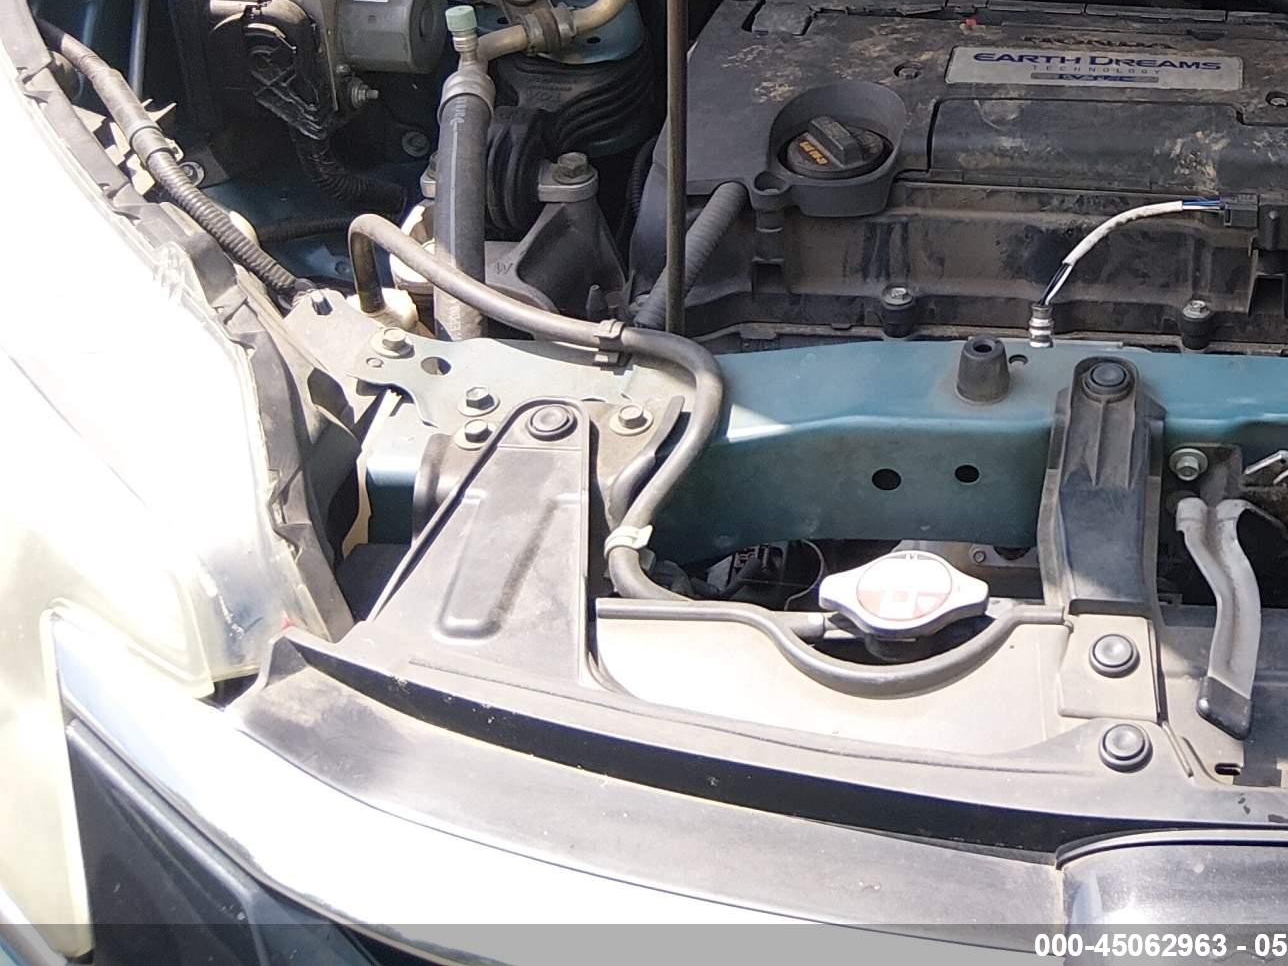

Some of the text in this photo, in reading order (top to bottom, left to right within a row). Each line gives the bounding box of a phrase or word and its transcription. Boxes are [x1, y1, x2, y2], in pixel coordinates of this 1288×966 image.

[973, 52, 1222, 71] EARTH DREAMS
[1032, 64, 1162, 76] TECHNOLOGY
